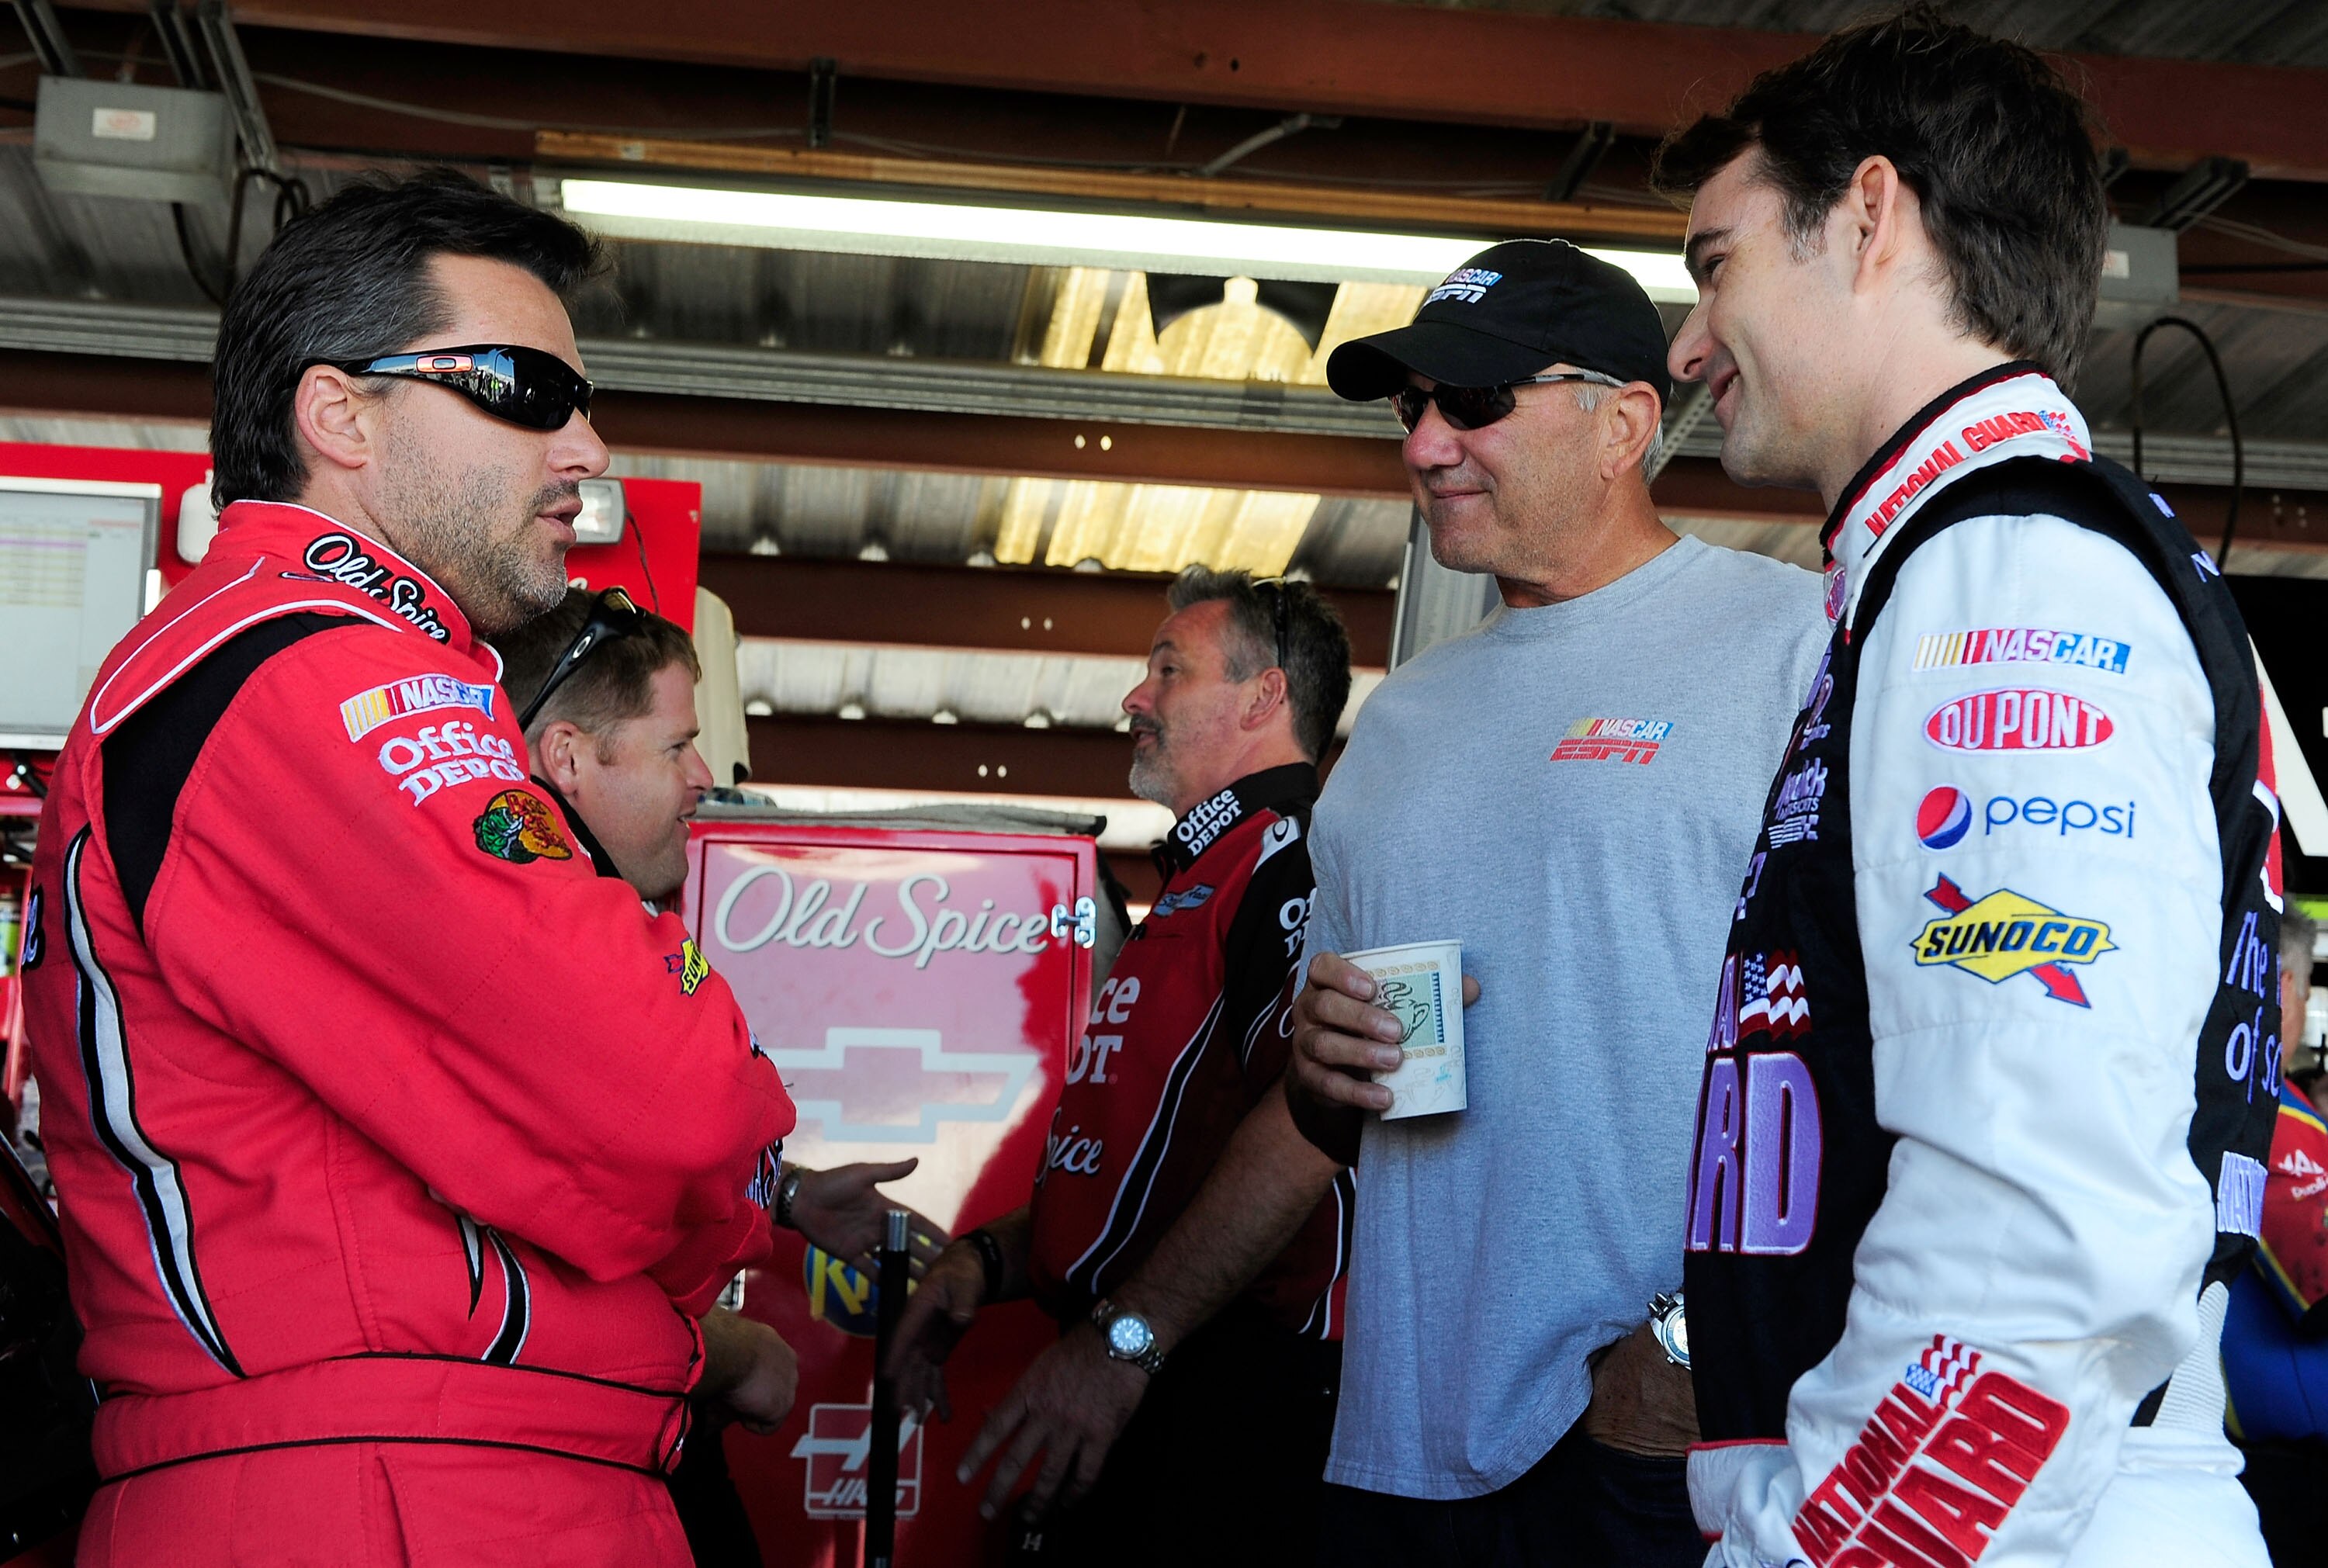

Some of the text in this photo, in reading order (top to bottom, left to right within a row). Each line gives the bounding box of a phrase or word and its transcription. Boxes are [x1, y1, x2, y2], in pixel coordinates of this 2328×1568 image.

[1980, 629, 2118, 670] NASCAR
[1595, 718, 1666, 740] NASCAR
[1550, 739, 1661, 765] ESPN
[398, 757, 525, 807] DEPO
[1176, 789, 1235, 843] Office
[1187, 800, 1242, 857] DEPOT
[1985, 795, 2136, 839] pepsi
[715, 865, 1049, 970] Old Spice
[1922, 921, 2100, 958] SUNOCO
